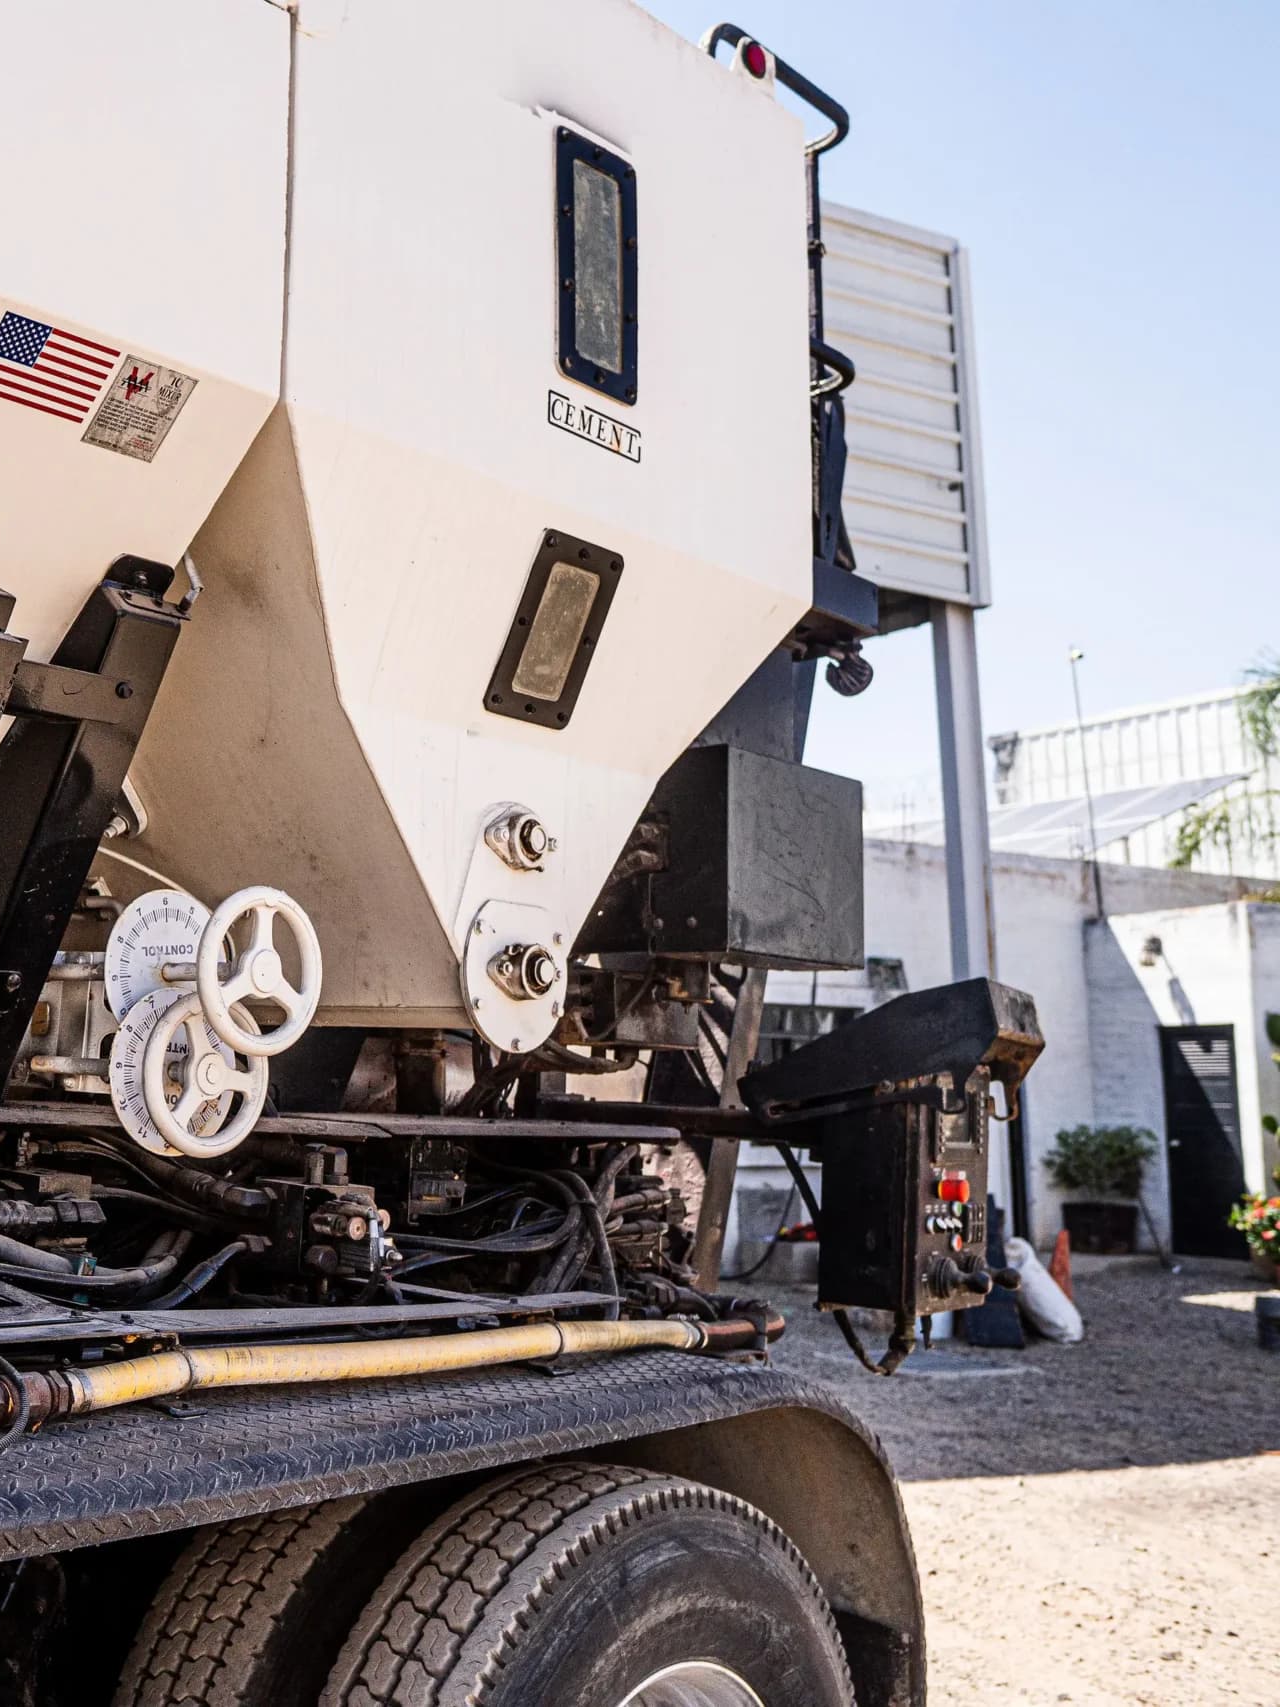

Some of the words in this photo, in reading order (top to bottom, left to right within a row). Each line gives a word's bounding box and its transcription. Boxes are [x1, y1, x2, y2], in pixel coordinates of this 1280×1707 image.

[551, 398, 638, 454] CEMENT
[162, 897, 169, 906] 6
[136, 907, 142, 917] 7
[188, 907, 195, 915] 5
[117, 935, 124, 944] 8
[141, 944, 194, 957] CONTROL
[126, 1024, 133, 1033] 8
[137, 1126, 148, 1138] 11
